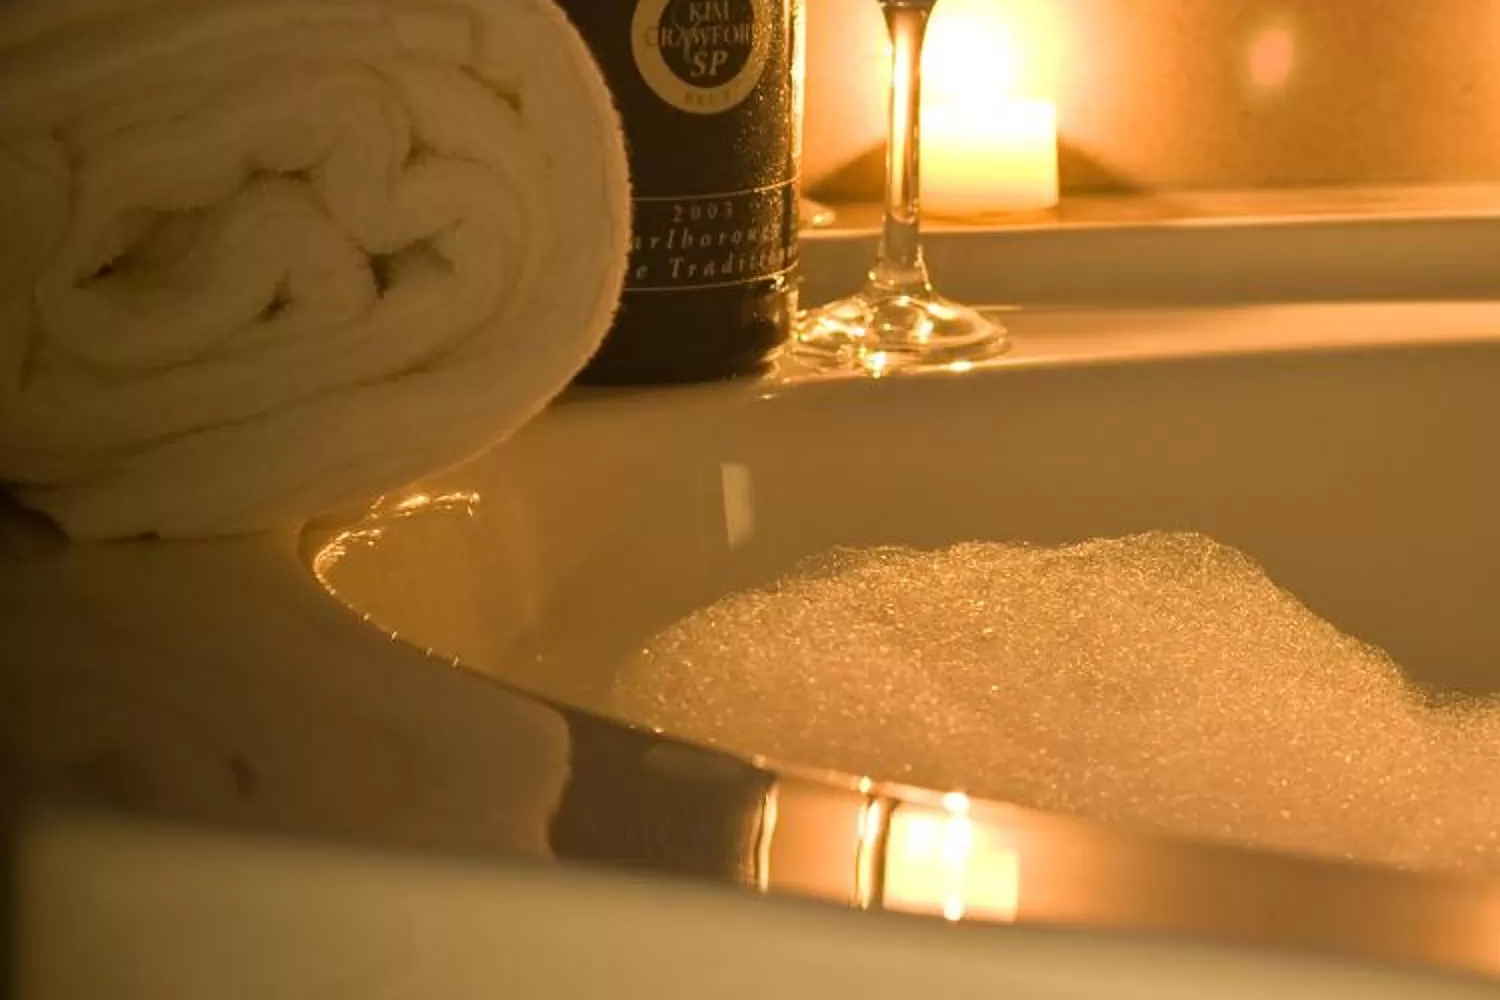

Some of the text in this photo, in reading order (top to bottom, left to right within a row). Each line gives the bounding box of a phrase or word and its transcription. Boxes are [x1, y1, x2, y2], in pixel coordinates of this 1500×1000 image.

[689, 0, 731, 24] KIM
[643, 22, 764, 48] CRAWFOR
[689, 49, 731, 78] SP
[672, 200, 734, 223] 2003
